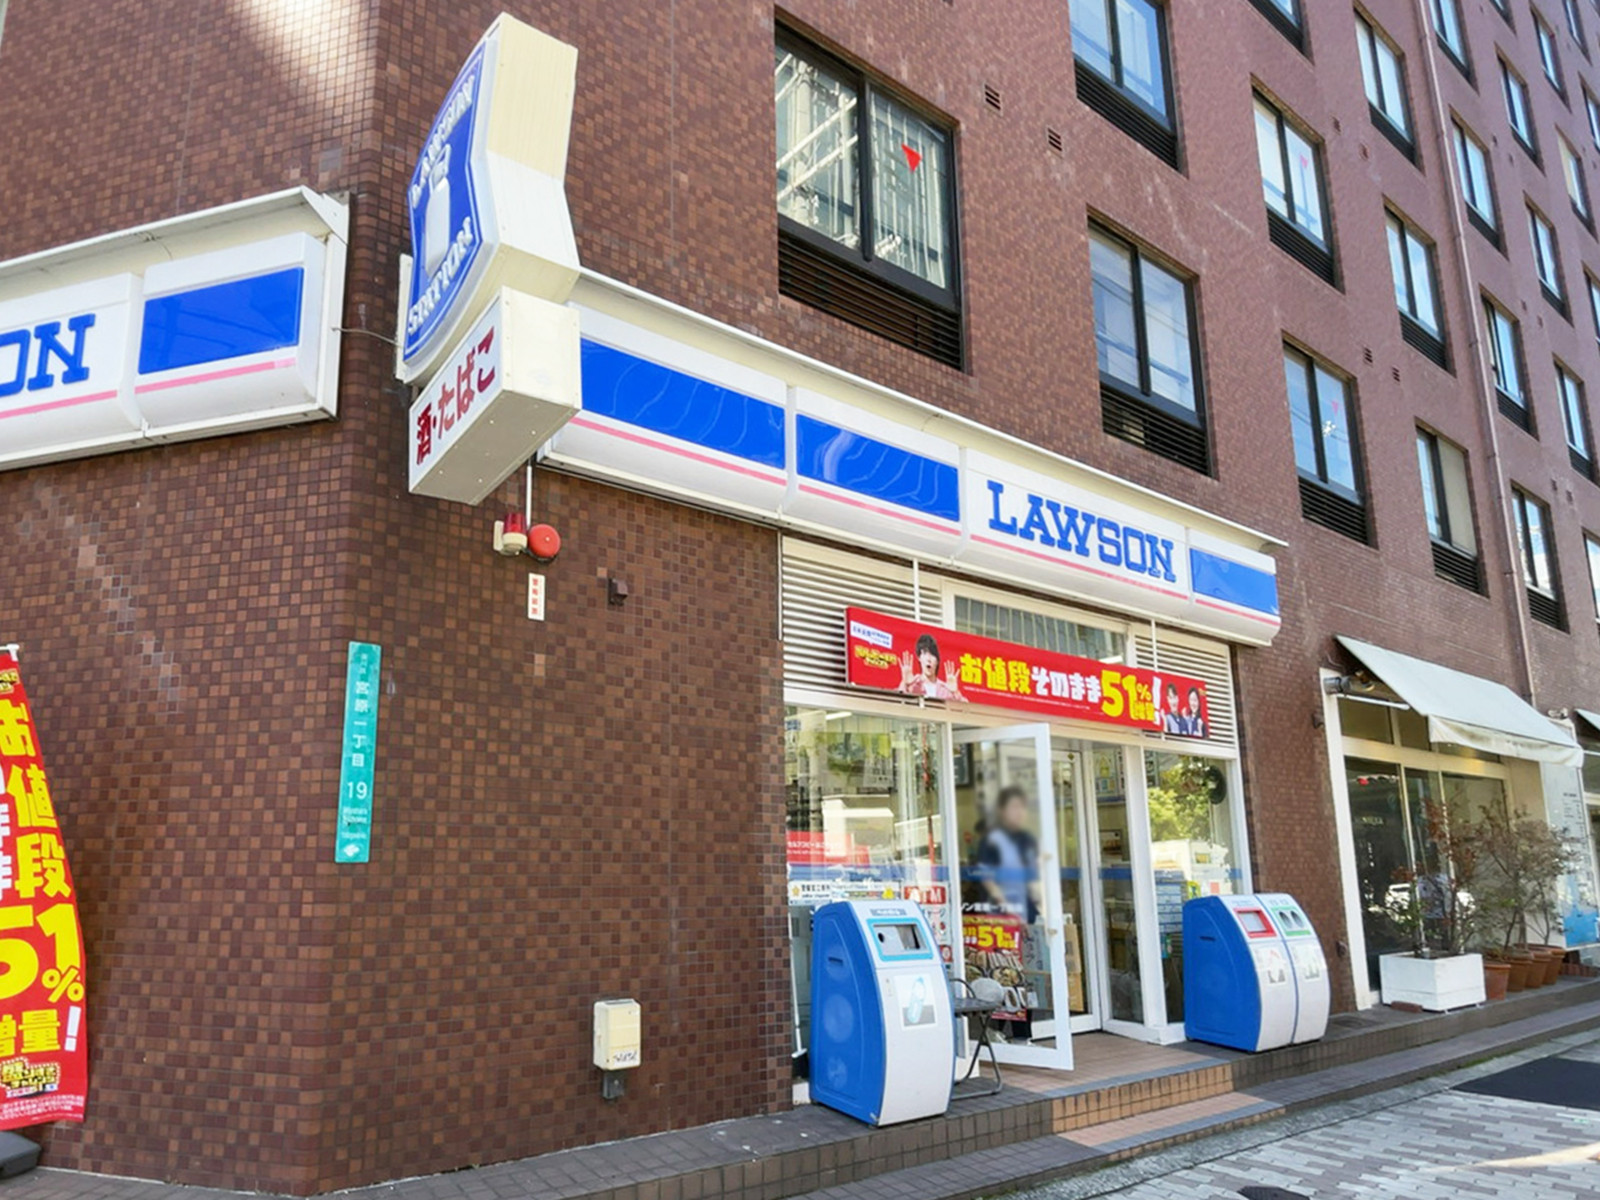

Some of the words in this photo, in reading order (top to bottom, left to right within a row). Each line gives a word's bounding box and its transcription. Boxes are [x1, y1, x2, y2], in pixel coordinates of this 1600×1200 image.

[416, 325, 496, 466] 酒・たばこ
[987, 479, 1176, 583] LAWSON
[352, 681, 371, 768] 宮原一丁目
[347, 781, 368, 800] 19
[909, 886, 943, 904] ATM
